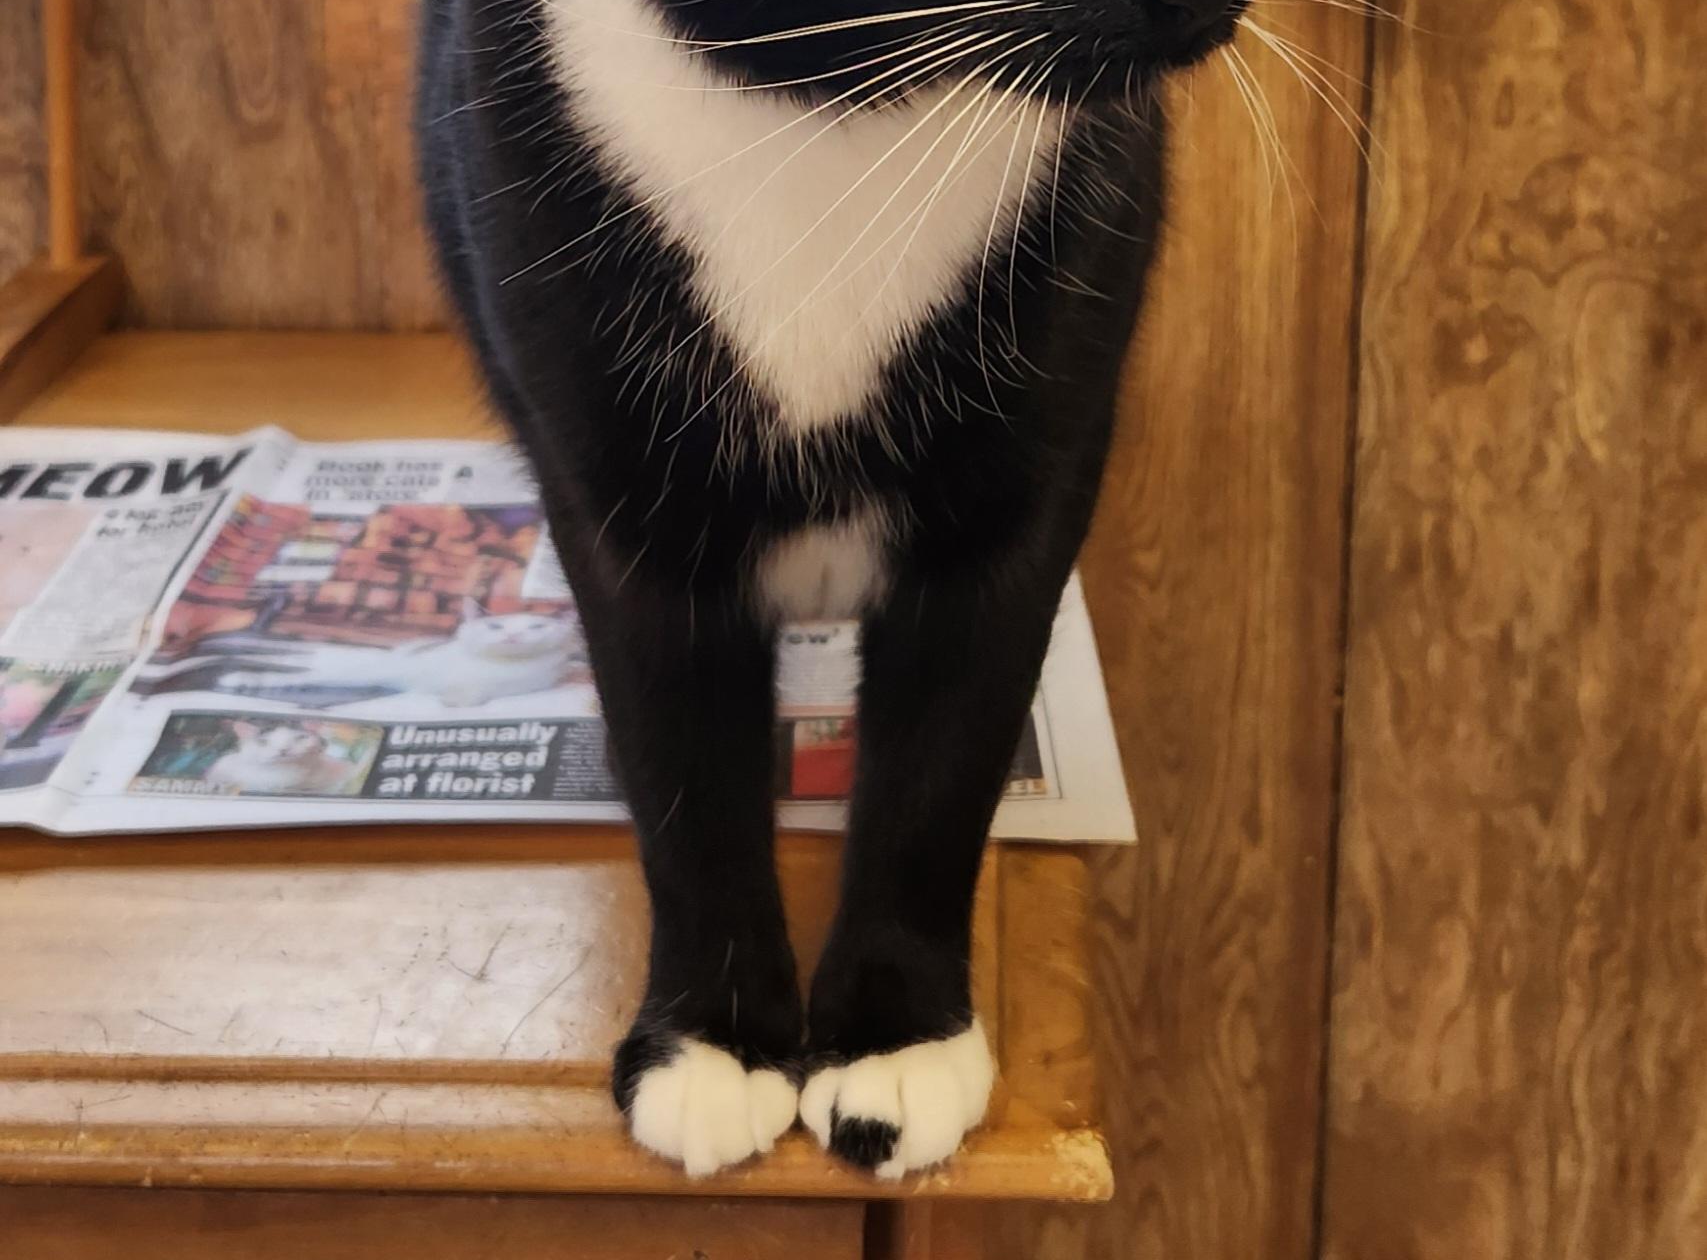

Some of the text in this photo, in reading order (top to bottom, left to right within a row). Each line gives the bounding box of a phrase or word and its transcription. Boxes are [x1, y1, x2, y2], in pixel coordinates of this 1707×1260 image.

[388, 722, 558, 747] Unusually
[381, 746, 549, 772] arranged
[377, 771, 536, 794] at florist
